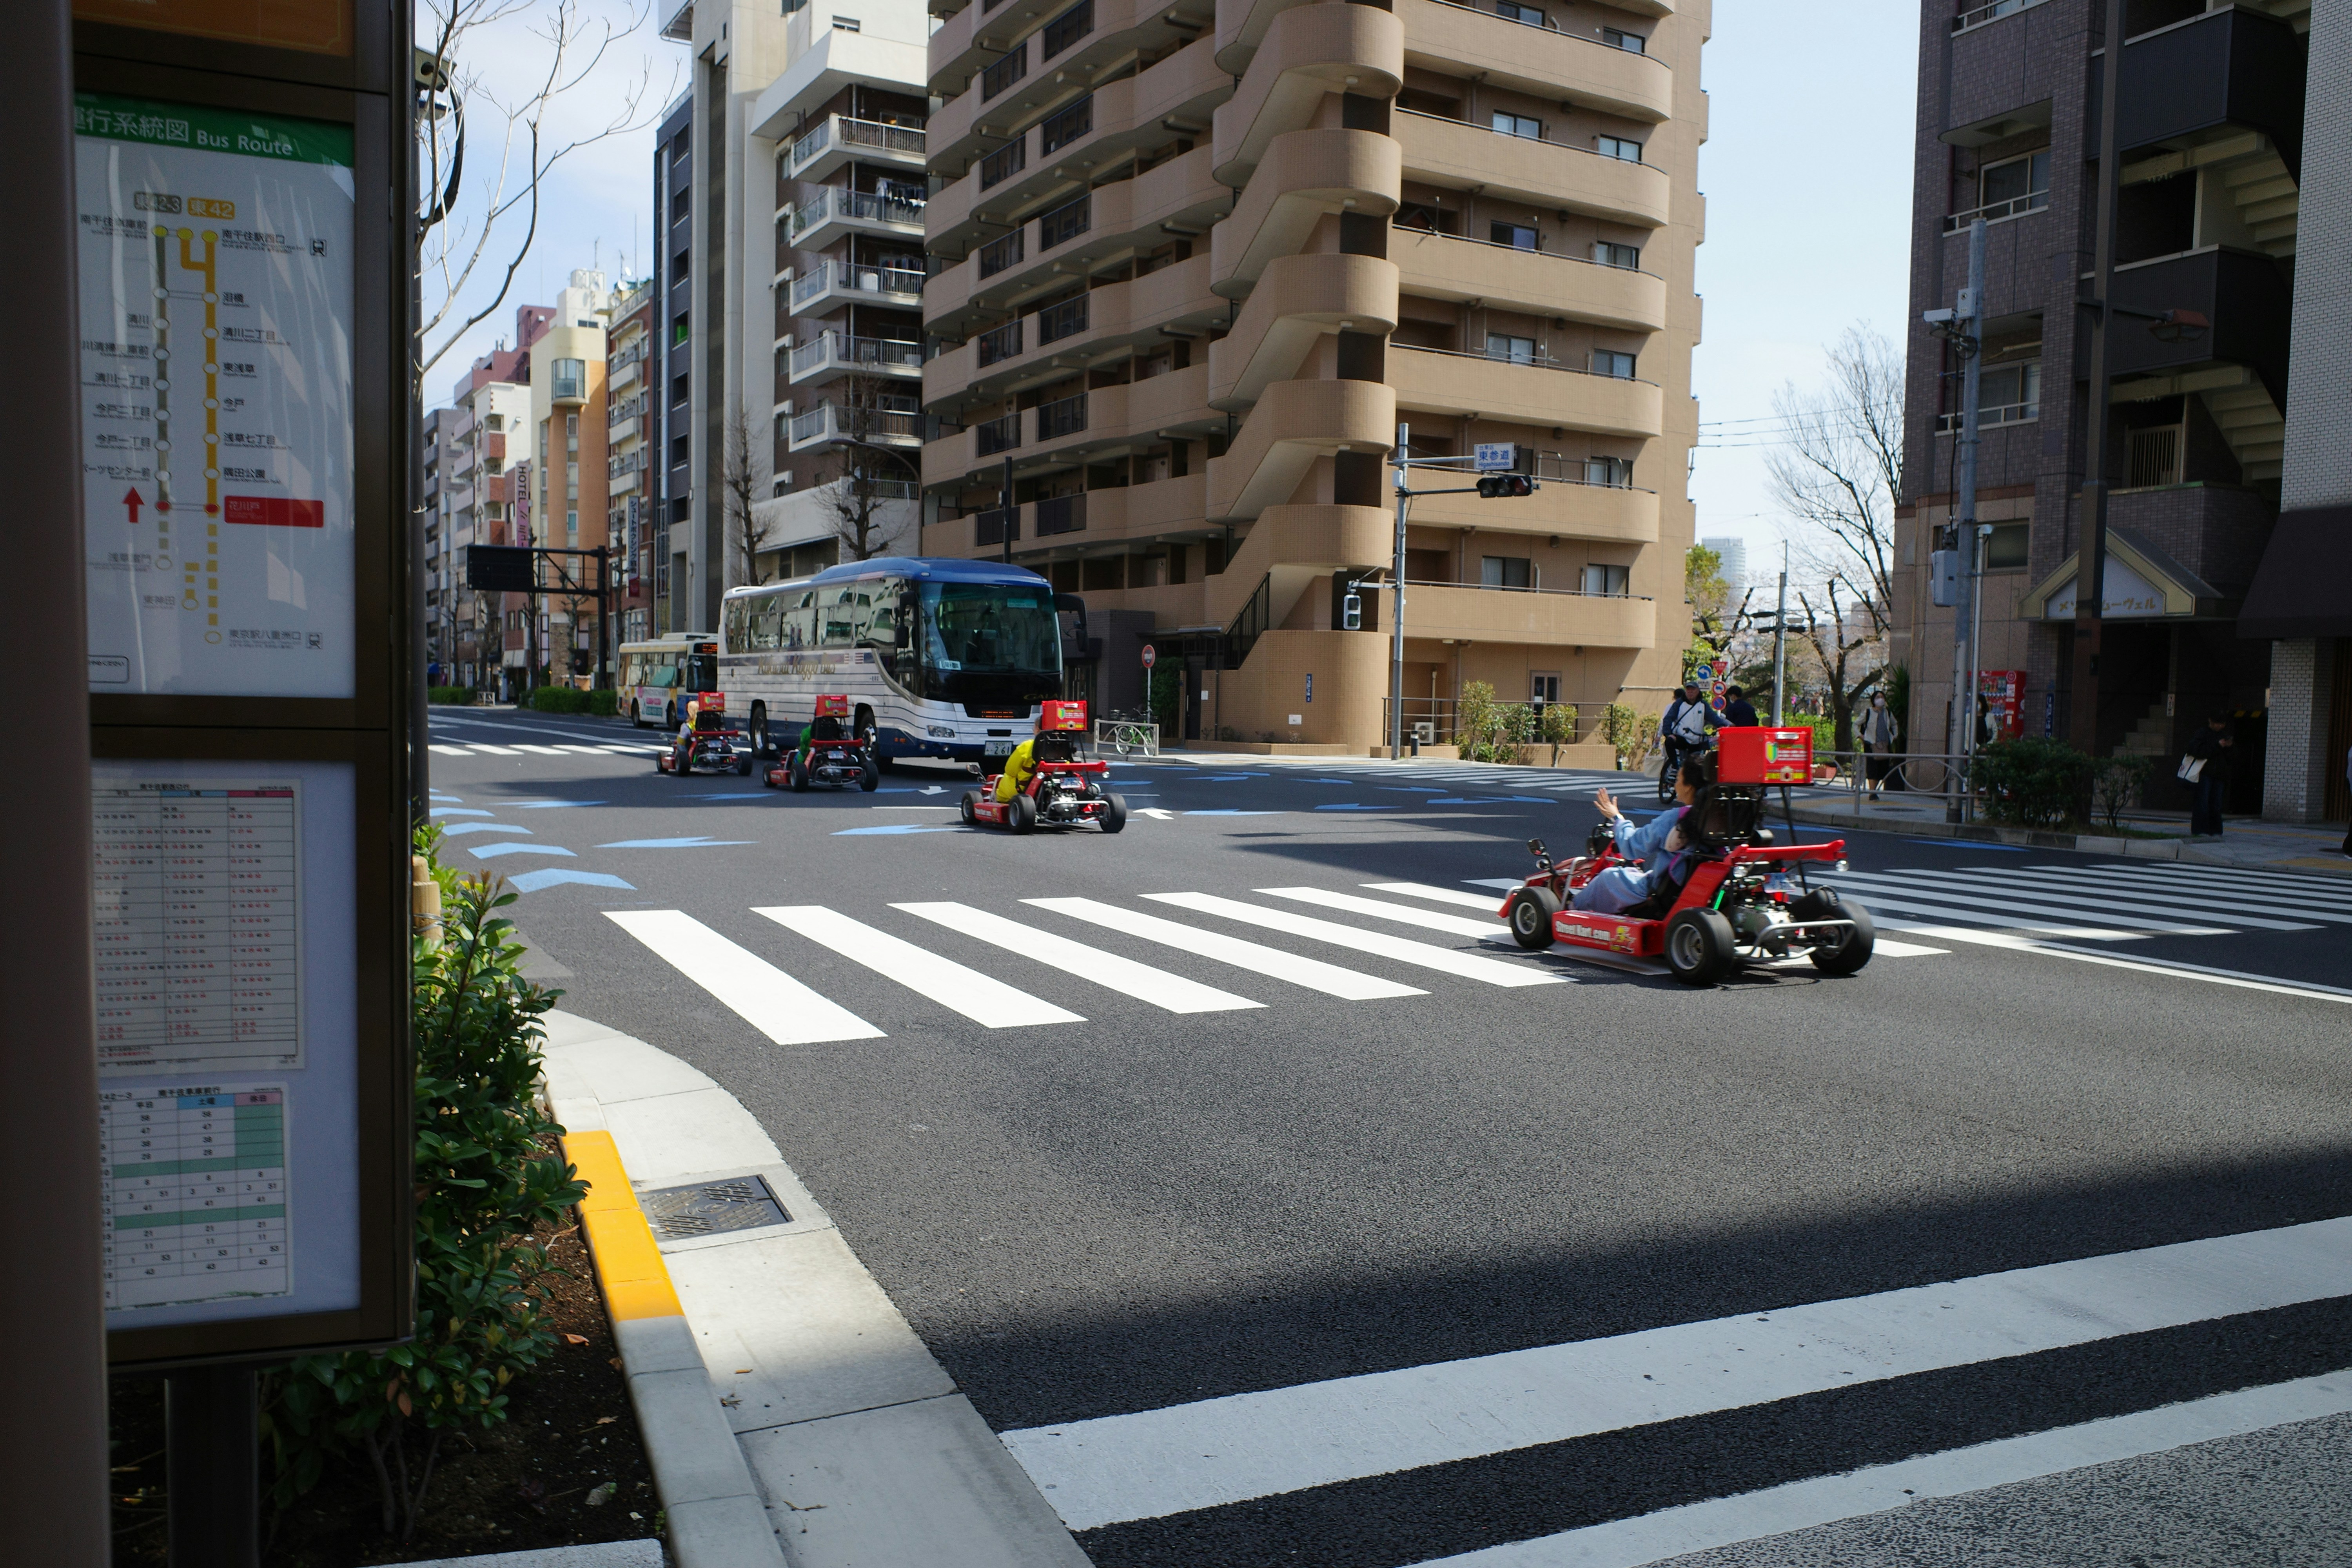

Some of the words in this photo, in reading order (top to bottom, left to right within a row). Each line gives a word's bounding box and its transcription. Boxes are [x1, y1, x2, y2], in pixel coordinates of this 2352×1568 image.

[197, 129, 229, 149] Bus
[237, 134, 292, 156] Route
[81, 214, 147, 229] 南千住庫前
[128, 314, 149, 324] 清川
[223, 327, 275, 341] 清川二丁目
[223, 362, 255, 374] 東浅草
[96, 372, 150, 386] 清川一丁目
[223, 398, 245, 408] 今戸
[96, 403, 151, 417] 今戸二丁目
[96, 434, 151, 447] 今戸一丁目
[223, 432, 276, 445] 浅草七丁目
[1479, 449, 1510, 461] 東参道
[223, 467, 265, 479] 隅田公園
[229, 501, 260, 511] 花川戸
[2059, 597, 2155, 612] メムーヴェル
[994, 746, 1010, 754] 261
[1555, 920, 1576, 935] Street
[1576, 924, 1610, 941] Kart.com
[136, 1101, 153, 1109] 平日
[198, 1097, 216, 1105] 土曜
